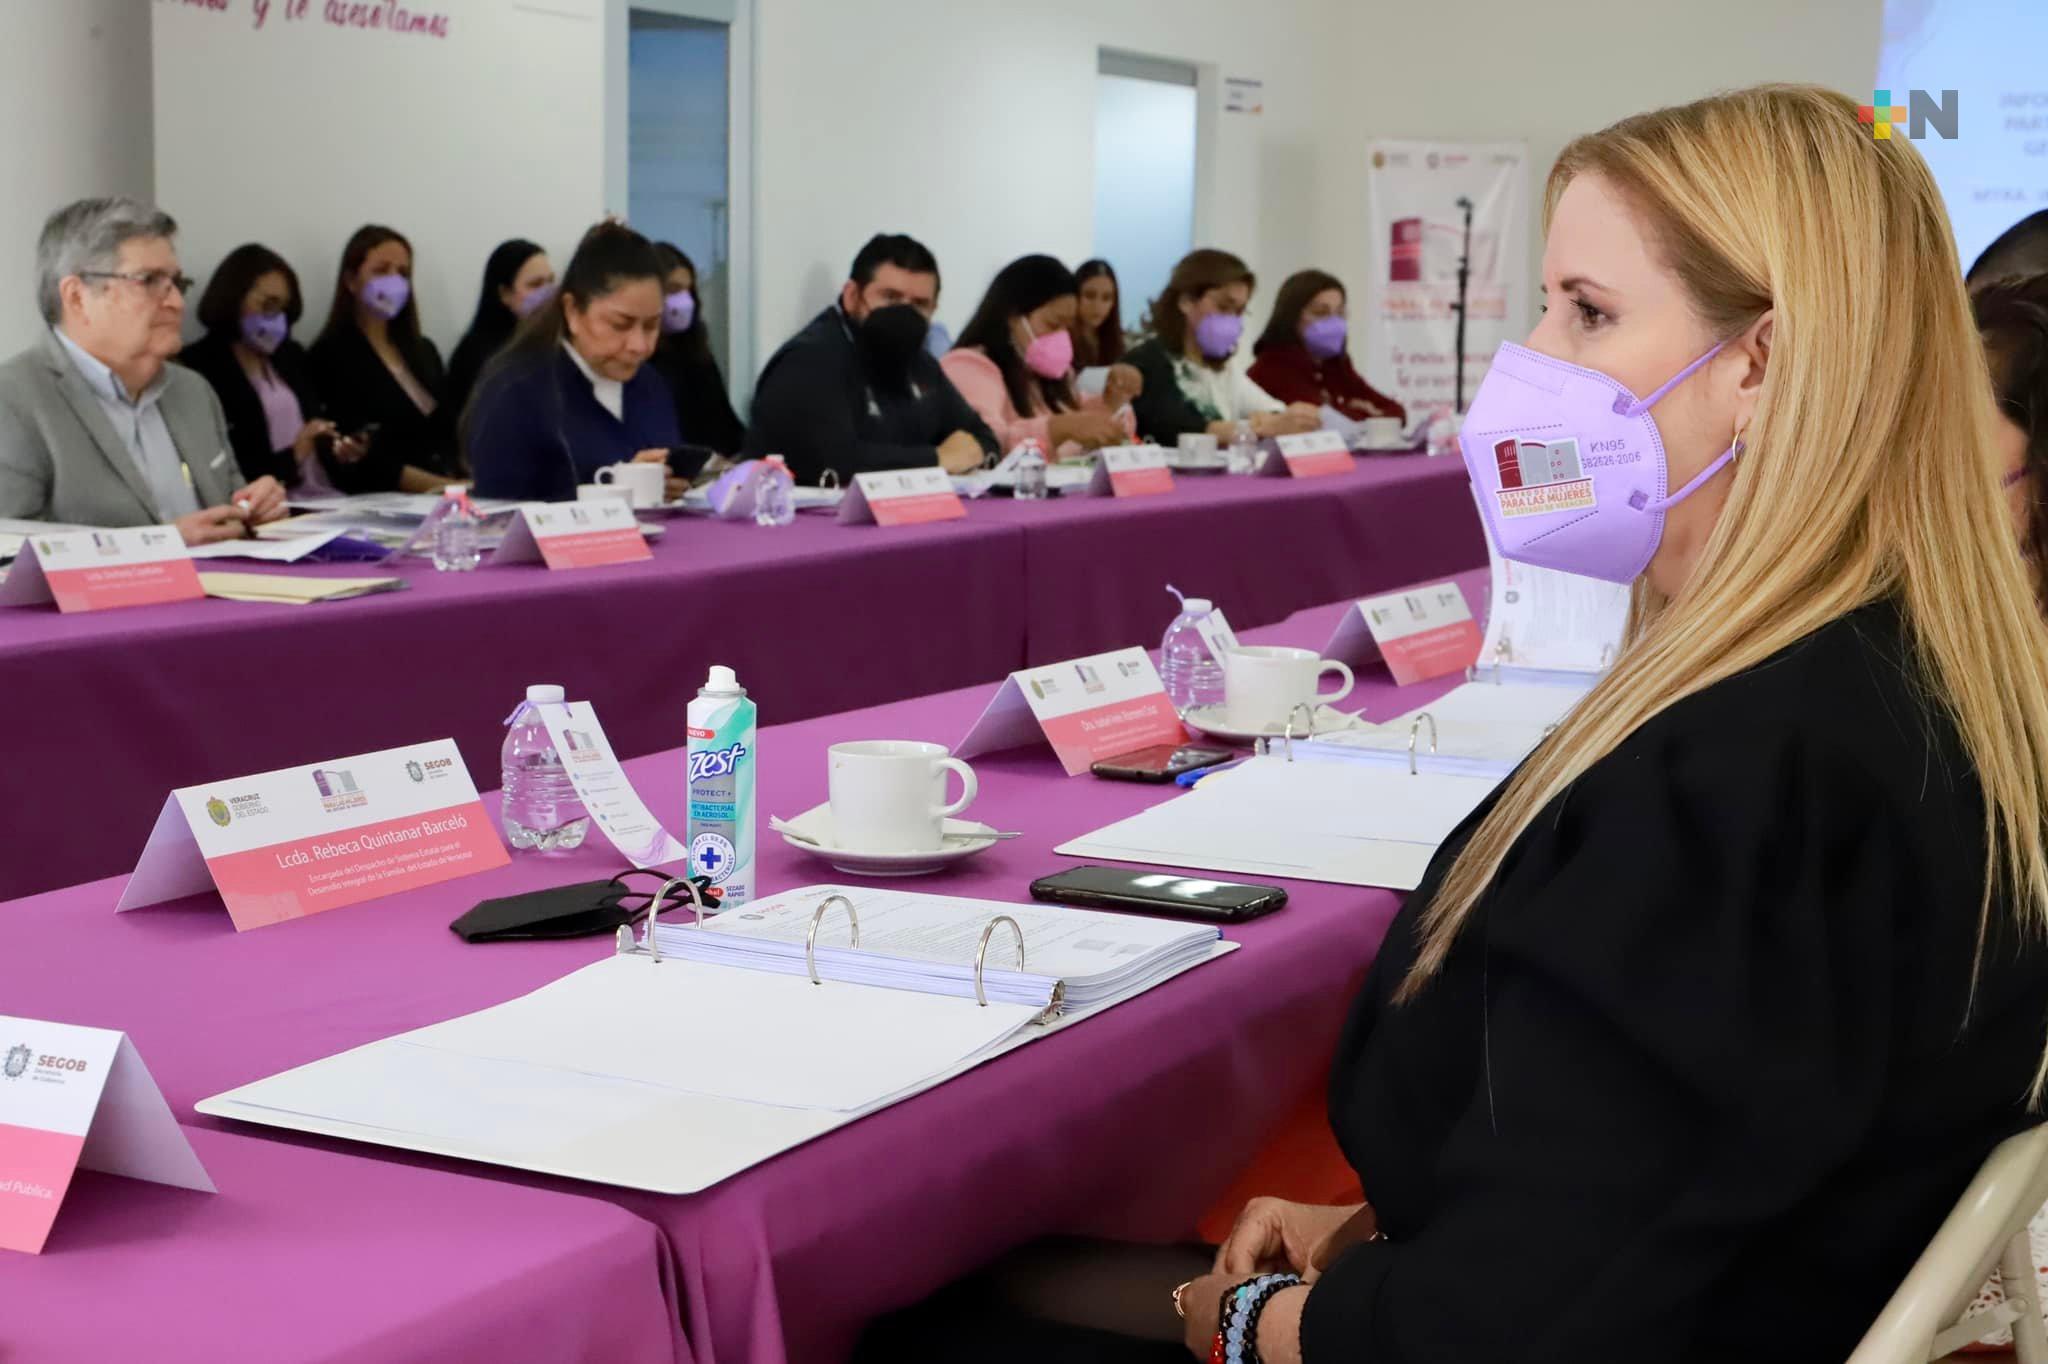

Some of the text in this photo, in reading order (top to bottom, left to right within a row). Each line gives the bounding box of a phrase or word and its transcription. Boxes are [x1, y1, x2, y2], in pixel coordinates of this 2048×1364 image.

[1590, 439, 1625, 453] KN95
[1501, 489, 1592, 509] PARA LAS MUJERES
[423, 758, 452, 770] SEGOB
[275, 814, 468, 869] Lcda. Rebeca Quintanar Barceló
[37, 1054, 88, 1072] SEGOB
